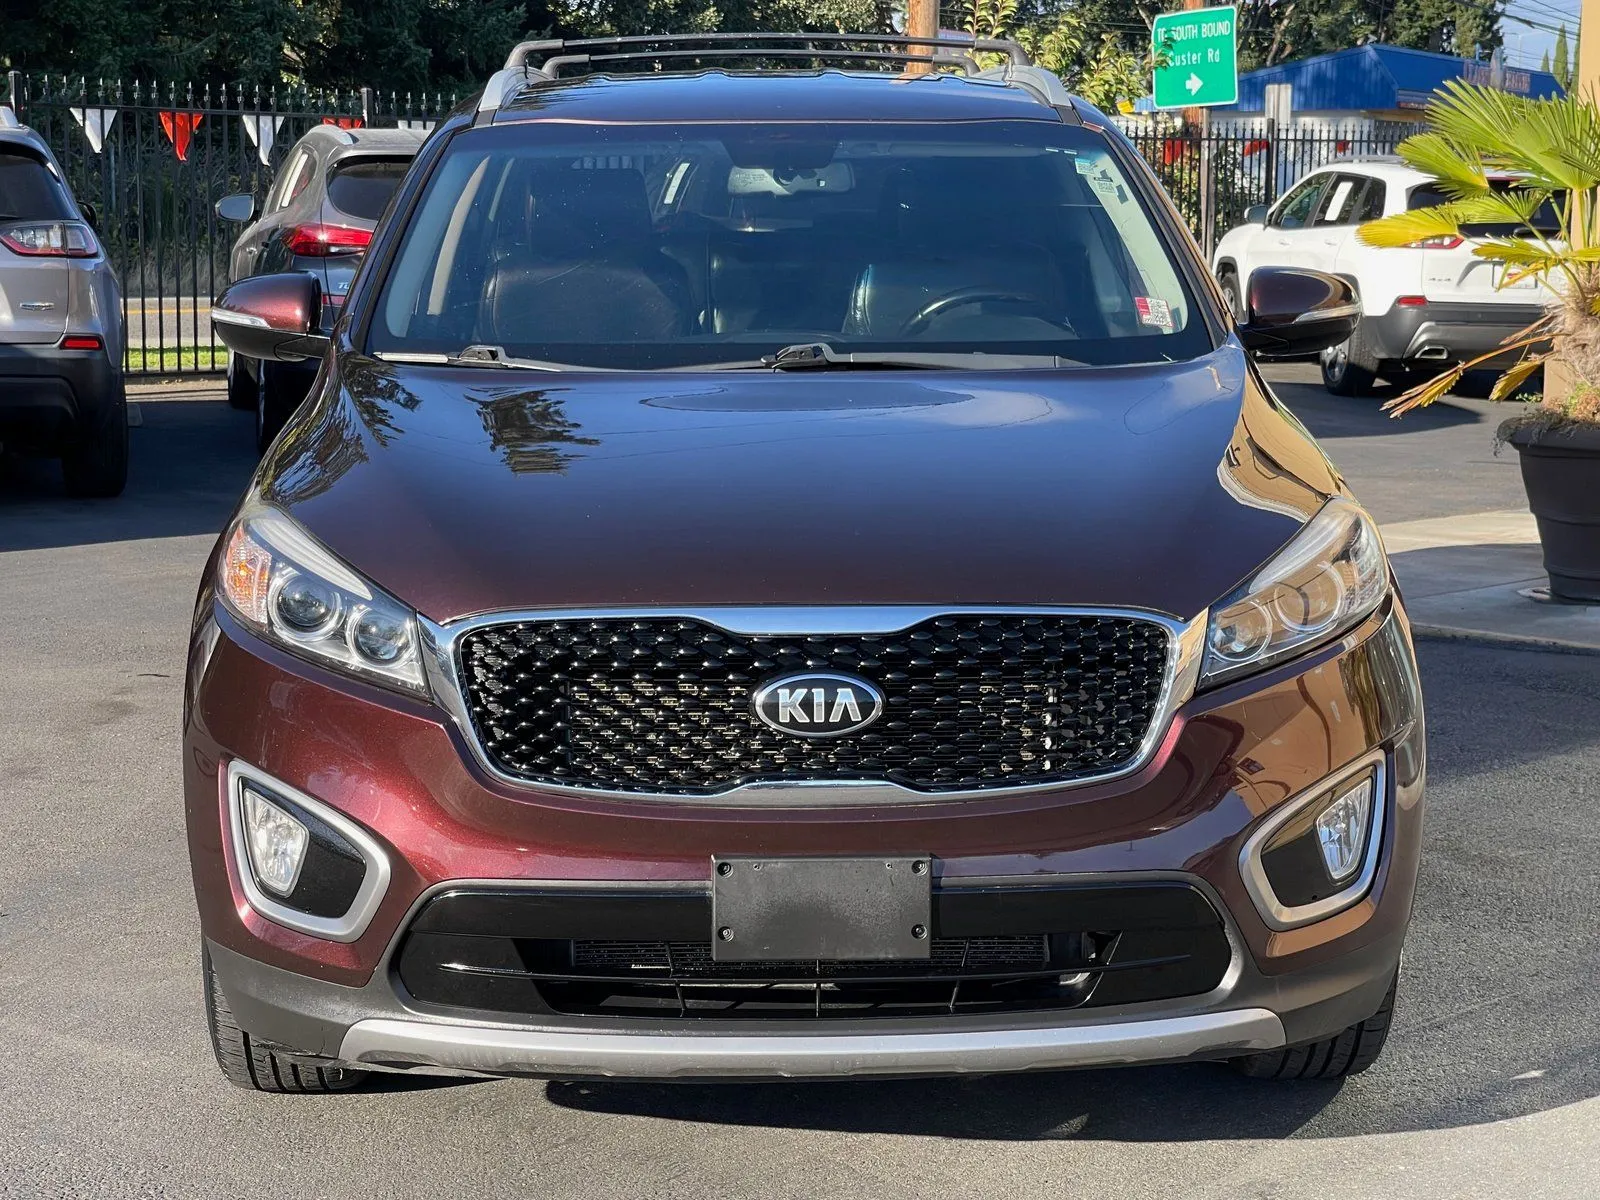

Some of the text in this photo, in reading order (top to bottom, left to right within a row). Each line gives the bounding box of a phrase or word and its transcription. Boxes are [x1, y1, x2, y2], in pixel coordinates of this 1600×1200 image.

[1171, 24, 1198, 41] SOUTH
[1201, 20, 1231, 38] BOUND
[1168, 48, 1220, 67] Custer Rd
[777, 688, 862, 723] KIA
